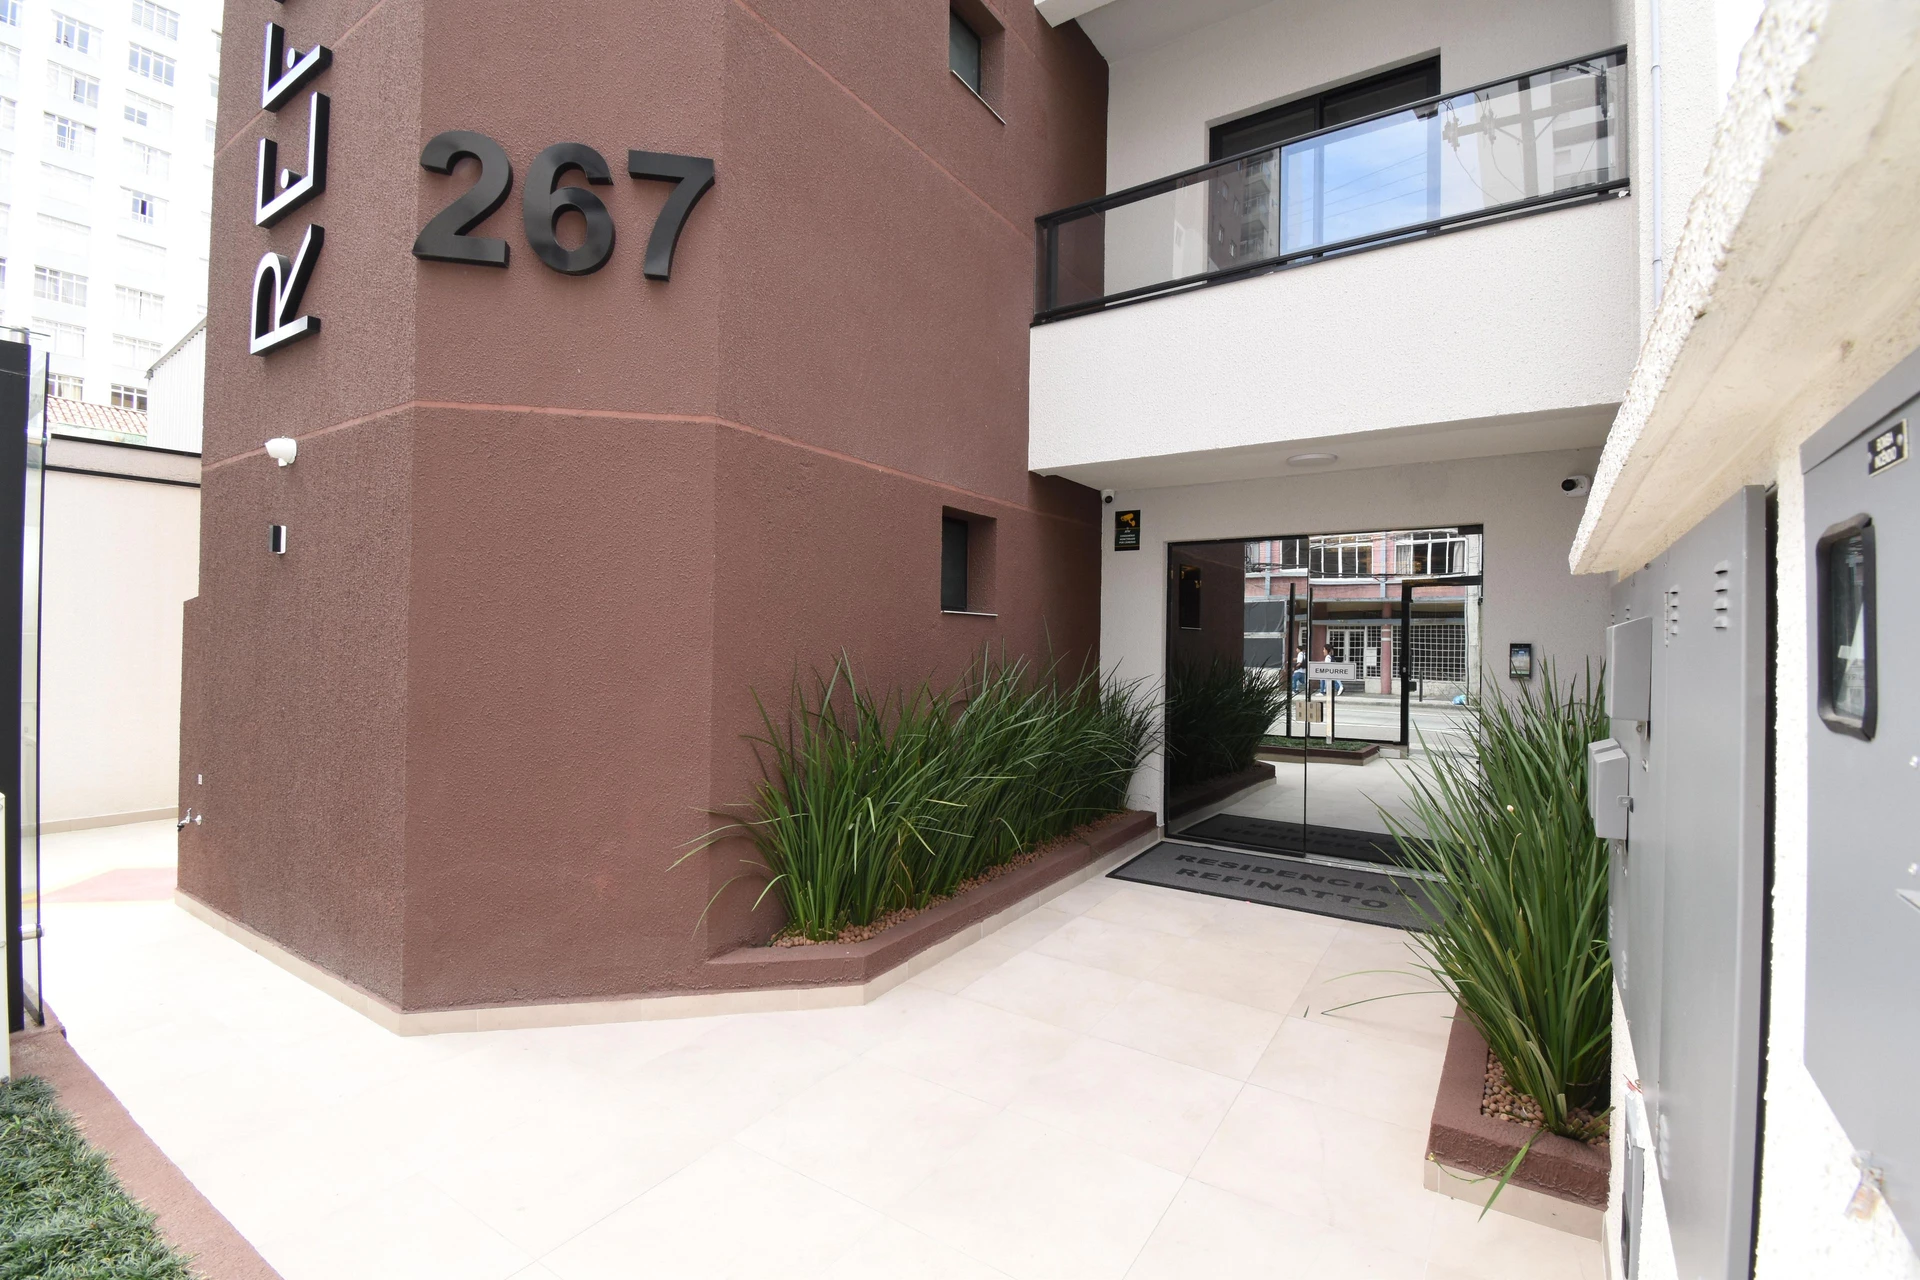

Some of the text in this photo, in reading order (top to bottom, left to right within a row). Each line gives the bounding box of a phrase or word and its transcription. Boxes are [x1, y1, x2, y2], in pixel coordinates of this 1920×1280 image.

[251, 0, 333, 357] REF
[412, 130, 715, 282] 267
[1315, 667, 1349, 675] EMPURRE
[1174, 854, 1418, 898] RESIDENCIAL
[1176, 868, 1389, 909] REFINATTO
